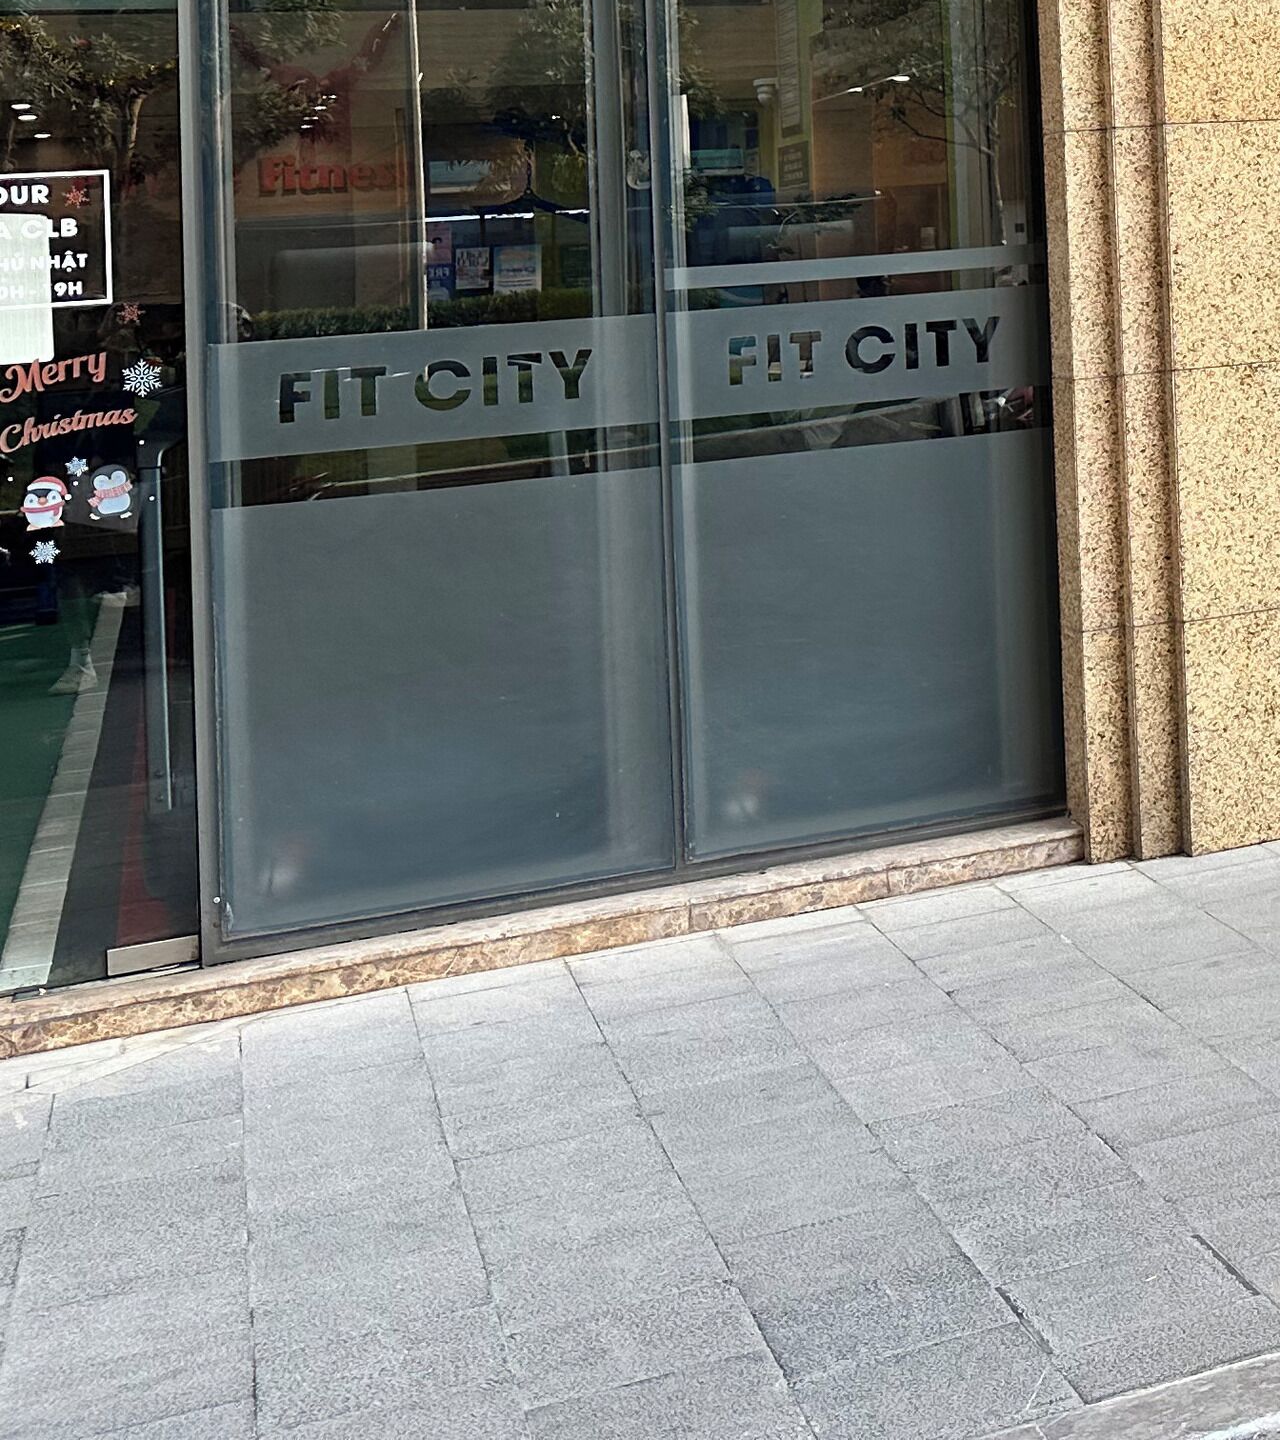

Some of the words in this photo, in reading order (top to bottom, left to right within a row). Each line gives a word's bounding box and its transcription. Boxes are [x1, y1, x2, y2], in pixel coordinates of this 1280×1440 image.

[21, 217, 79, 239] CLB
[30, 250, 88, 273] NHẬT
[729, 330, 822, 386] FIT
[844, 315, 1000, 376] CITY
[0, 351, 108, 403] Merry
[279, 366, 387, 423] FIT
[414, 348, 592, 411] CITY
[0, 405, 138, 454] Christmas
